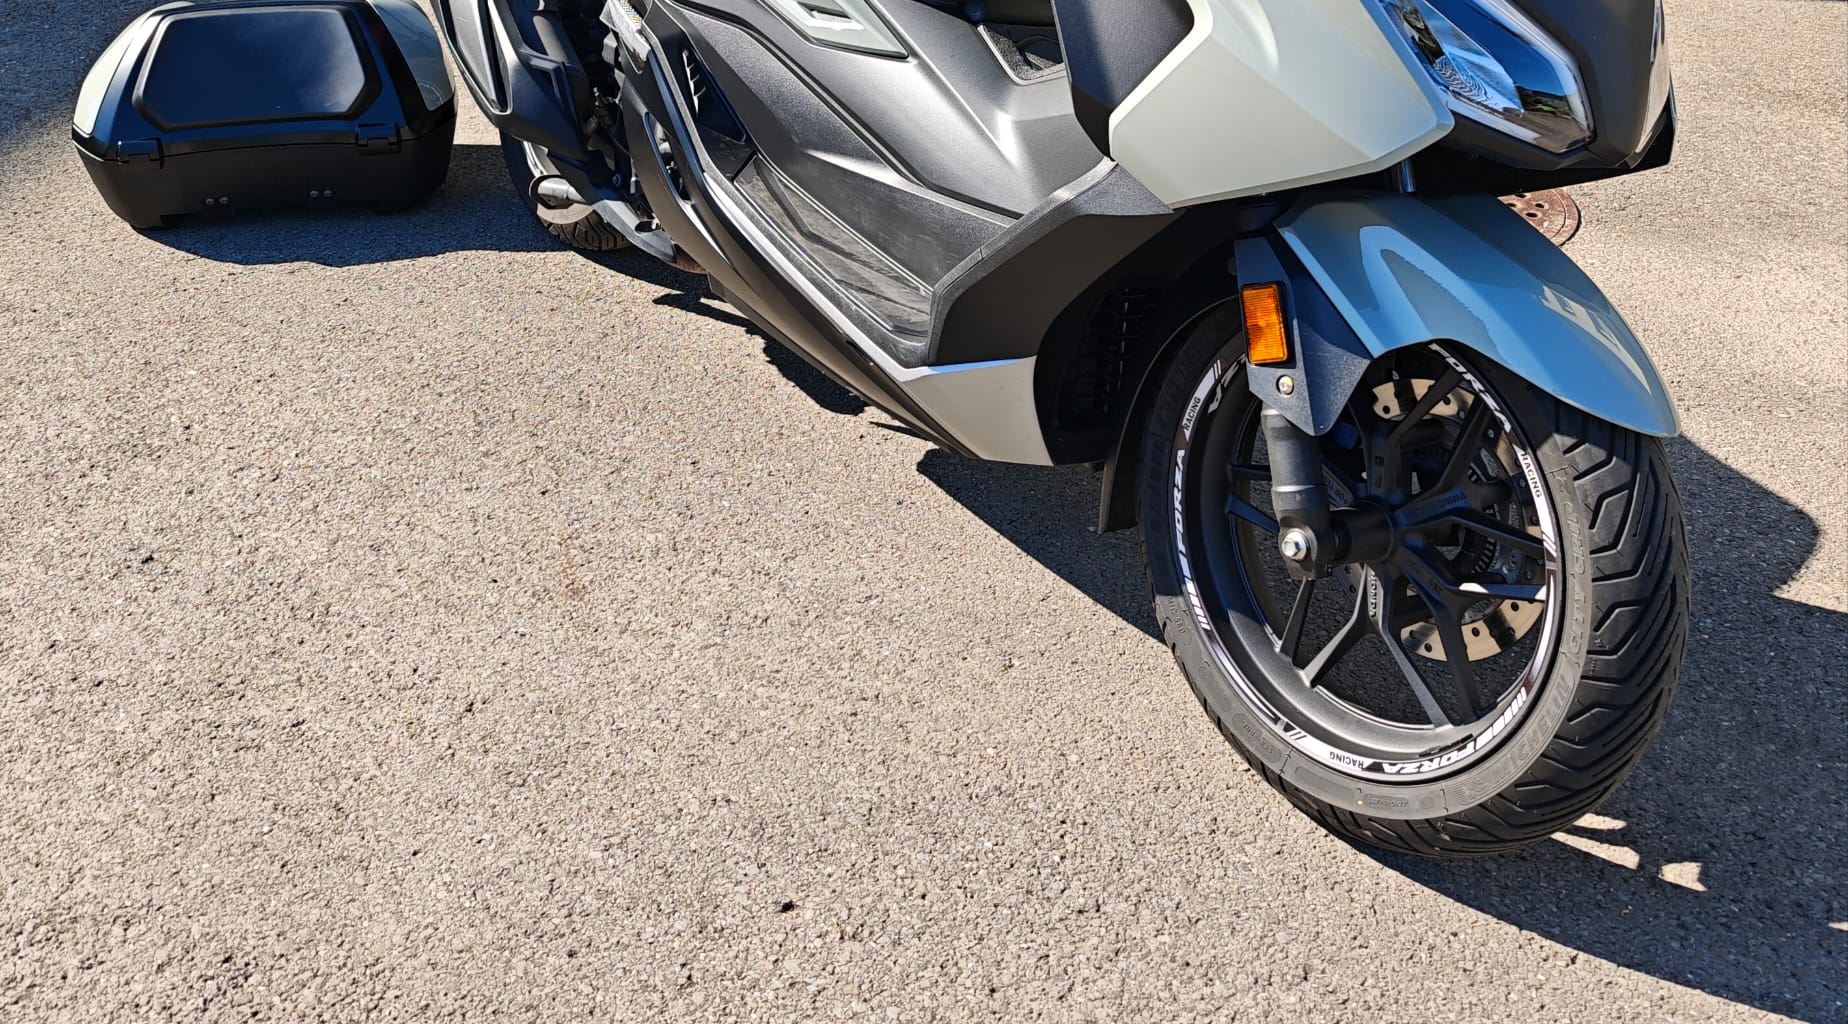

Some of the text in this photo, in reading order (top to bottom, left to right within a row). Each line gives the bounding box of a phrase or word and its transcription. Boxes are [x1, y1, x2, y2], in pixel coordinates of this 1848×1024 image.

[1428, 343, 1512, 433] FORZA
[1184, 395, 1202, 432] RACING
[1520, 452, 1543, 499] RACING
[1173, 449, 1187, 556] FORZA
[1329, 751, 1365, 769] RACING
[1382, 741, 1476, 775] FORZA
